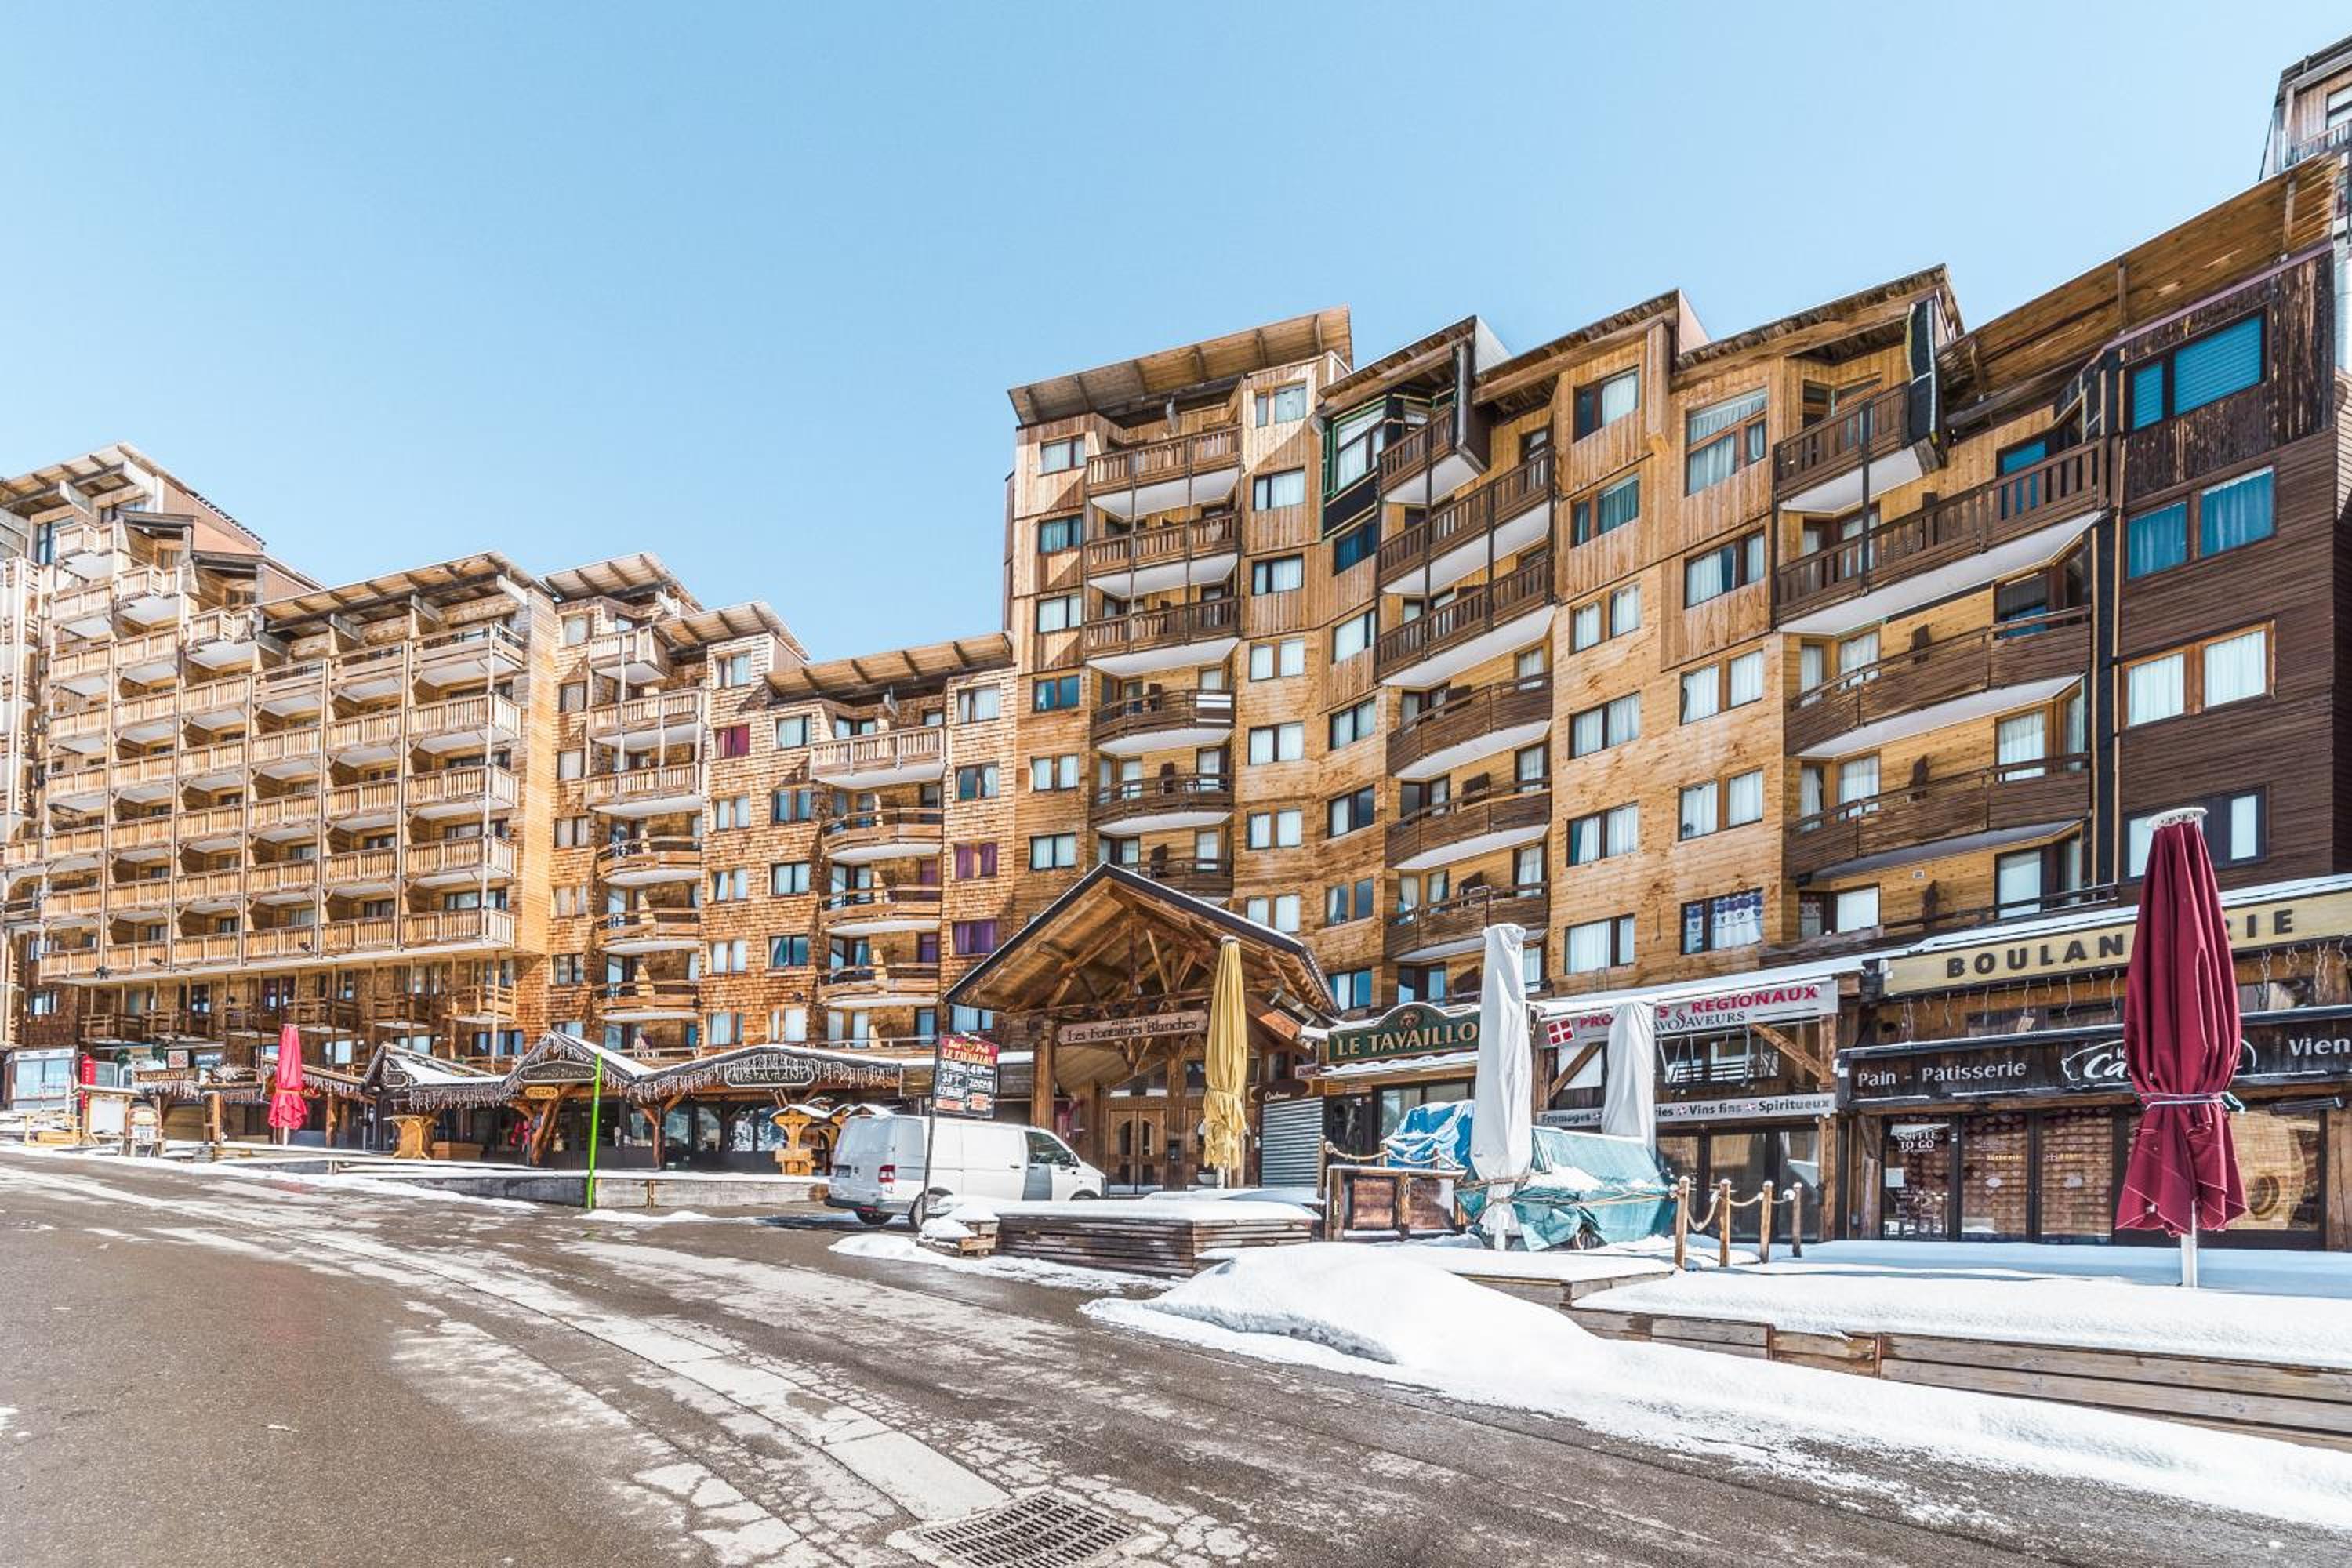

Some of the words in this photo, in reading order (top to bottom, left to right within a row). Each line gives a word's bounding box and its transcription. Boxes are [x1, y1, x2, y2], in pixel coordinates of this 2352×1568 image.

[1947, 909, 2293, 978] BOULANIE
[1067, 1030, 1086, 1041] Les
[1091, 1025, 1142, 1039] Fontaines
[1147, 1017, 1197, 1033] Blanches
[1336, 1034, 1360, 1056] LE
[1367, 1022, 1478, 1053] TAVAILLO
[949, 1039, 961, 1048] Bar
[975, 1044, 990, 1054] Pub
[2288, 1037, 2351, 1057] Vien
[1857, 1070, 1896, 1087] Pain
[1541, 1112, 1591, 1124] Fromages
[1690, 1104, 1715, 1115] Vins
[1719, 1103, 1741, 1115] fins
[1759, 1099, 1830, 1112] Spiritueux
[1900, 1141, 1914, 1149] TO
[1918, 1140, 1934, 1149] GO
